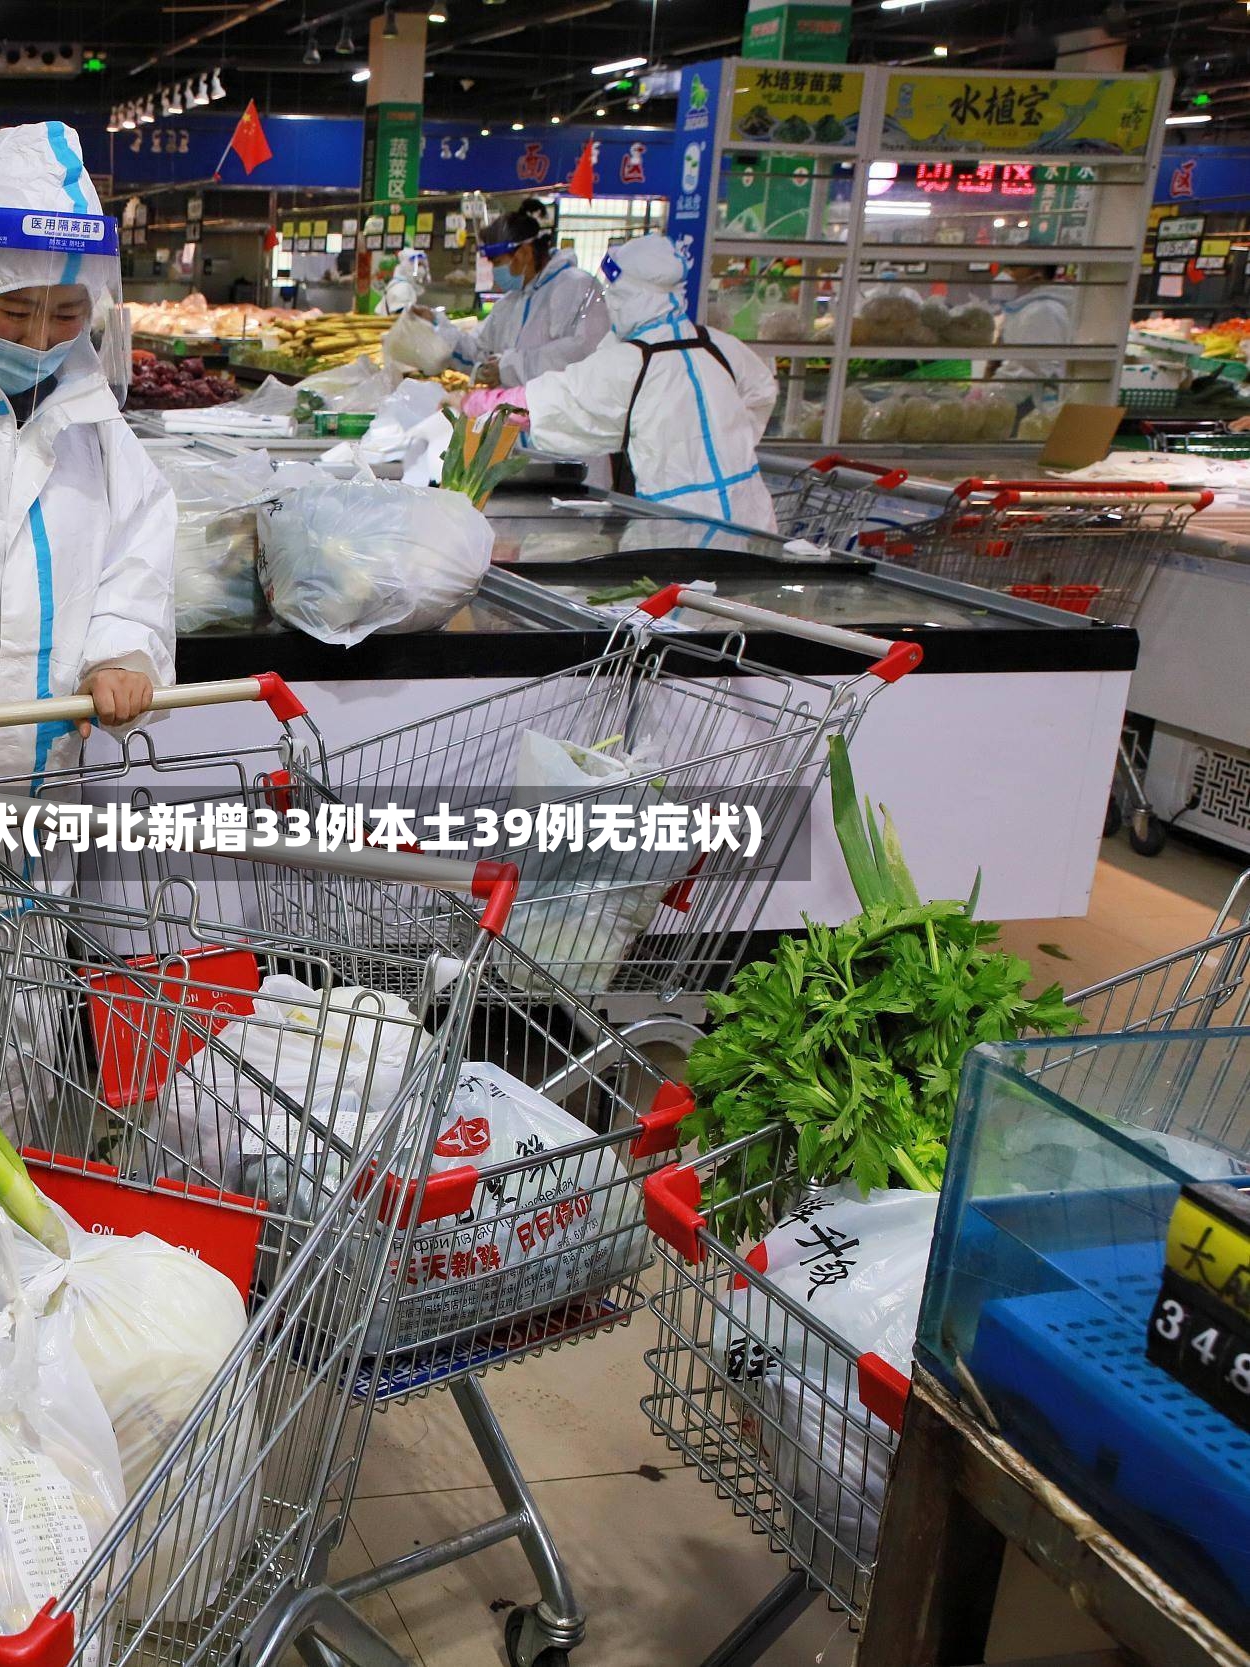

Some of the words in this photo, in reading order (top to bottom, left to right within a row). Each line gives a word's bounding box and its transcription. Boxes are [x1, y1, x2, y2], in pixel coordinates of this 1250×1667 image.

[949, 83, 1050, 127] 水植宝
[31, 217, 100, 234] 医用隔离面罩
[91, 1223, 115, 1236] ON
